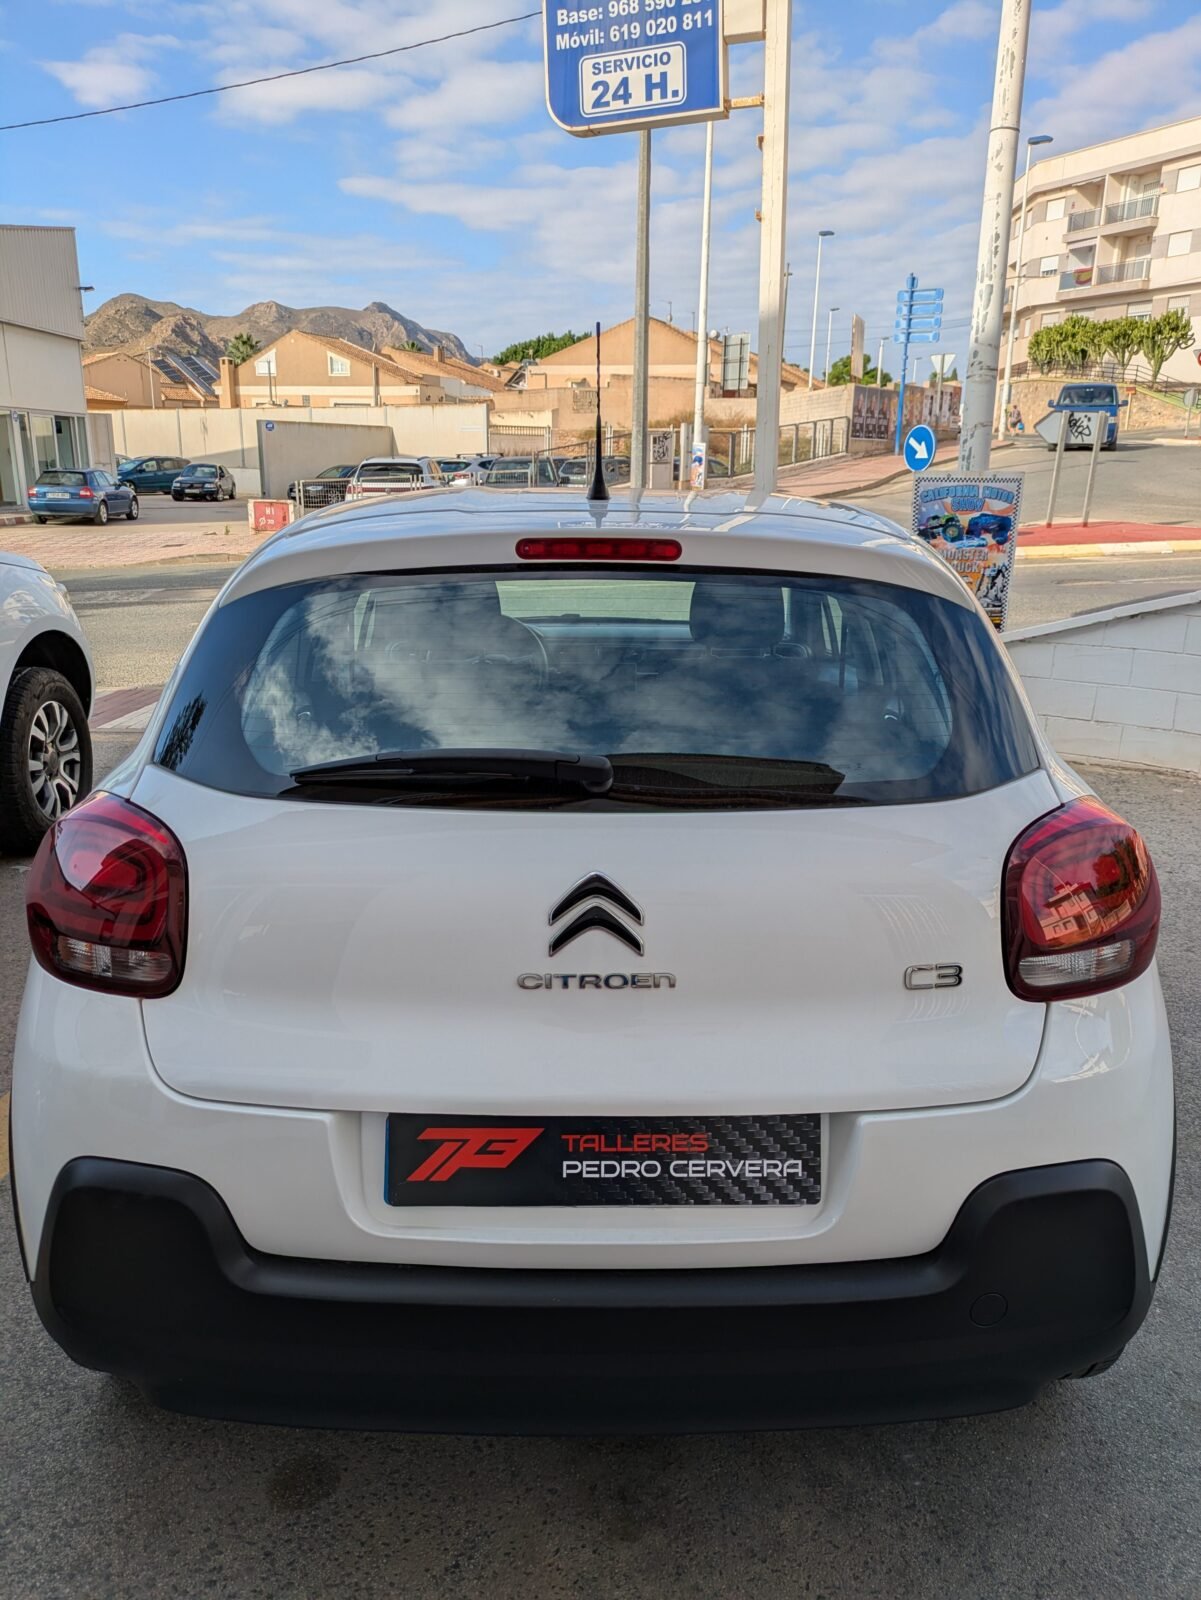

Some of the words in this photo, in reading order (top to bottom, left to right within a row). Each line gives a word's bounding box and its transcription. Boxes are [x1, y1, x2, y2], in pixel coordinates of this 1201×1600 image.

[557, 8, 603, 26] Base:
[608, 0, 640, 17] 968
[556, 28, 604, 50] Móvil:
[609, 22, 641, 42] 619
[645, 15, 677, 36] 020
[682, 8, 713, 31] 811
[591, 51, 671, 76] SERVICIO
[591, 76, 632, 110] 24
[644, 71, 680, 102] H.
[920, 485, 979, 504] CALIFORNIA
[951, 561, 979, 573] RUCK
[904, 963, 963, 990] C3
[561, 1134, 708, 1152] TALLERES
[562, 1160, 662, 1178] PEDRO
[669, 1159, 803, 1178] CERVERA
